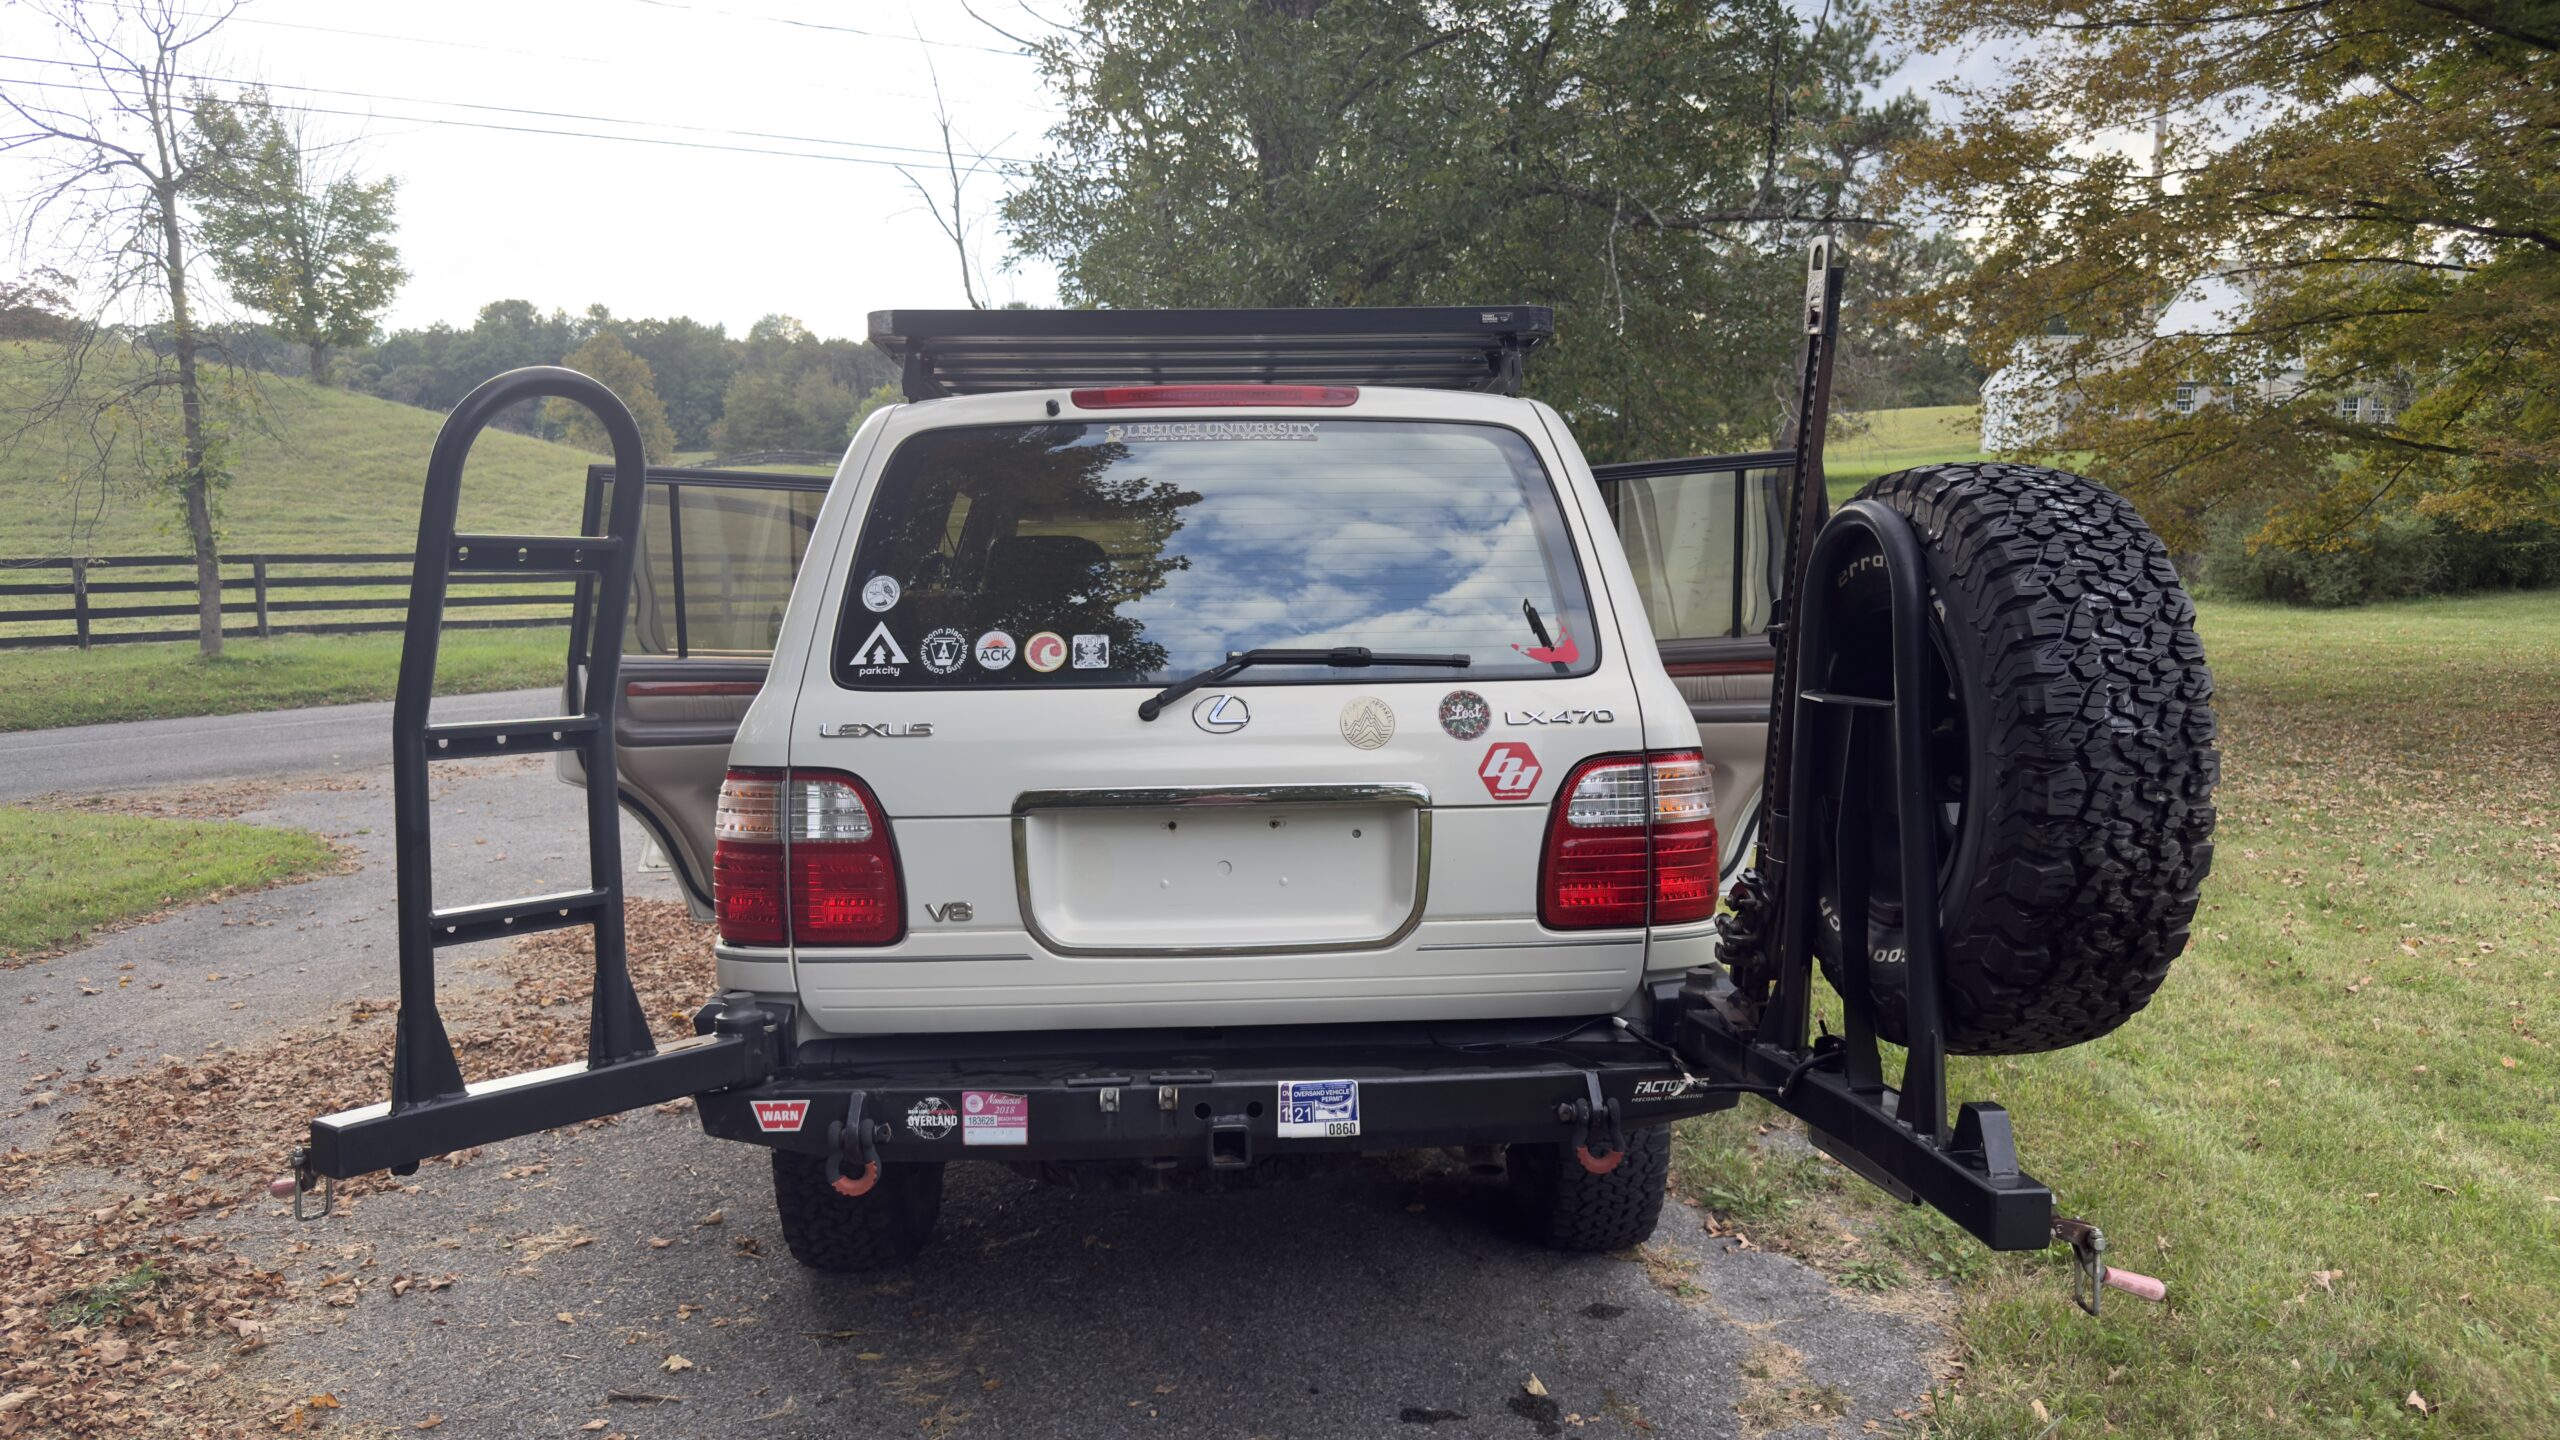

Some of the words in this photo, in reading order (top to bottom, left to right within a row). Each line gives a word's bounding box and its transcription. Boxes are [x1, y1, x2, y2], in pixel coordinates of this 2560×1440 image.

[1127, 424, 1200, 437] LEHIGH
[1206, 423, 1319, 436] UNIVERSITY
[1838, 554, 1889, 588] erra
[922, 628, 944, 644] bonn
[945, 628, 966, 643] place
[920, 644, 945, 675] company
[945, 644, 969, 674] brewing
[980, 649, 1011, 661] ACK
[1446, 703, 1483, 720] Lost
[819, 722, 934, 738] LEXUS
[925, 902, 973, 923] V8
[762, 1110, 799, 1121] WARN
[994, 1105, 1016, 1114] 2018
[1294, 1107, 1311, 1122] 21
[907, 1115, 958, 1127] OVERLAND
[968, 1116, 995, 1125] 183628
[1328, 1122, 1356, 1136] 0860
